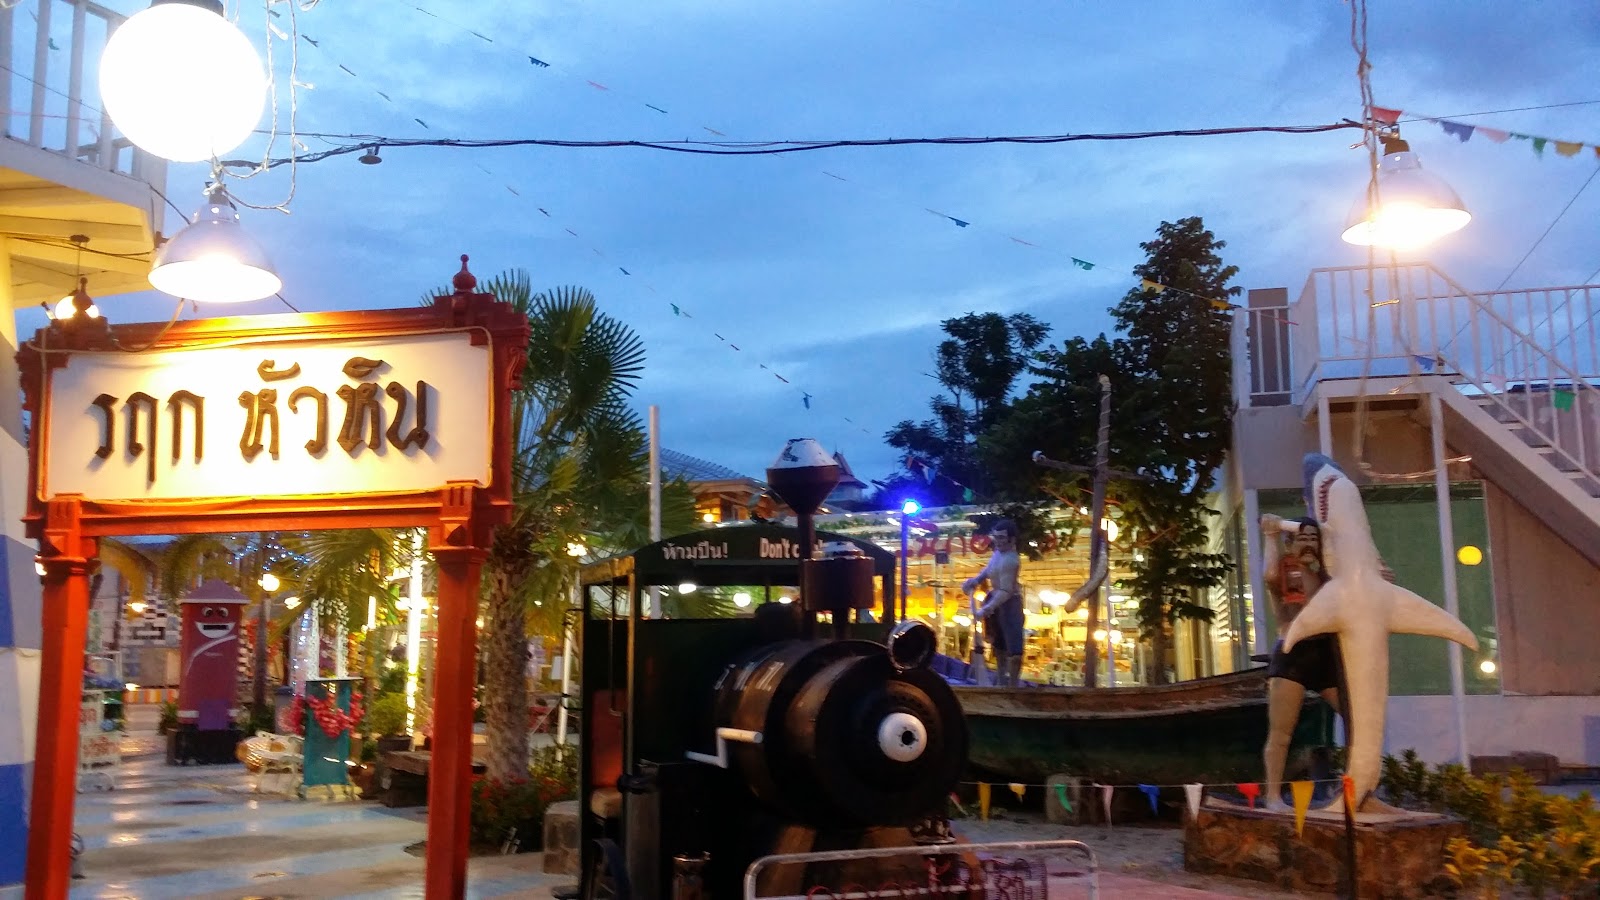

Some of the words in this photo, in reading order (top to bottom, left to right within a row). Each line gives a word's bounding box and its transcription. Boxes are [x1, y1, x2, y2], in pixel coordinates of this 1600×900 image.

[237, 357, 430, 460] หัวหิน
[662, 541, 728, 560] ห้ามปีน!
[759, 537, 790, 559] Don't
